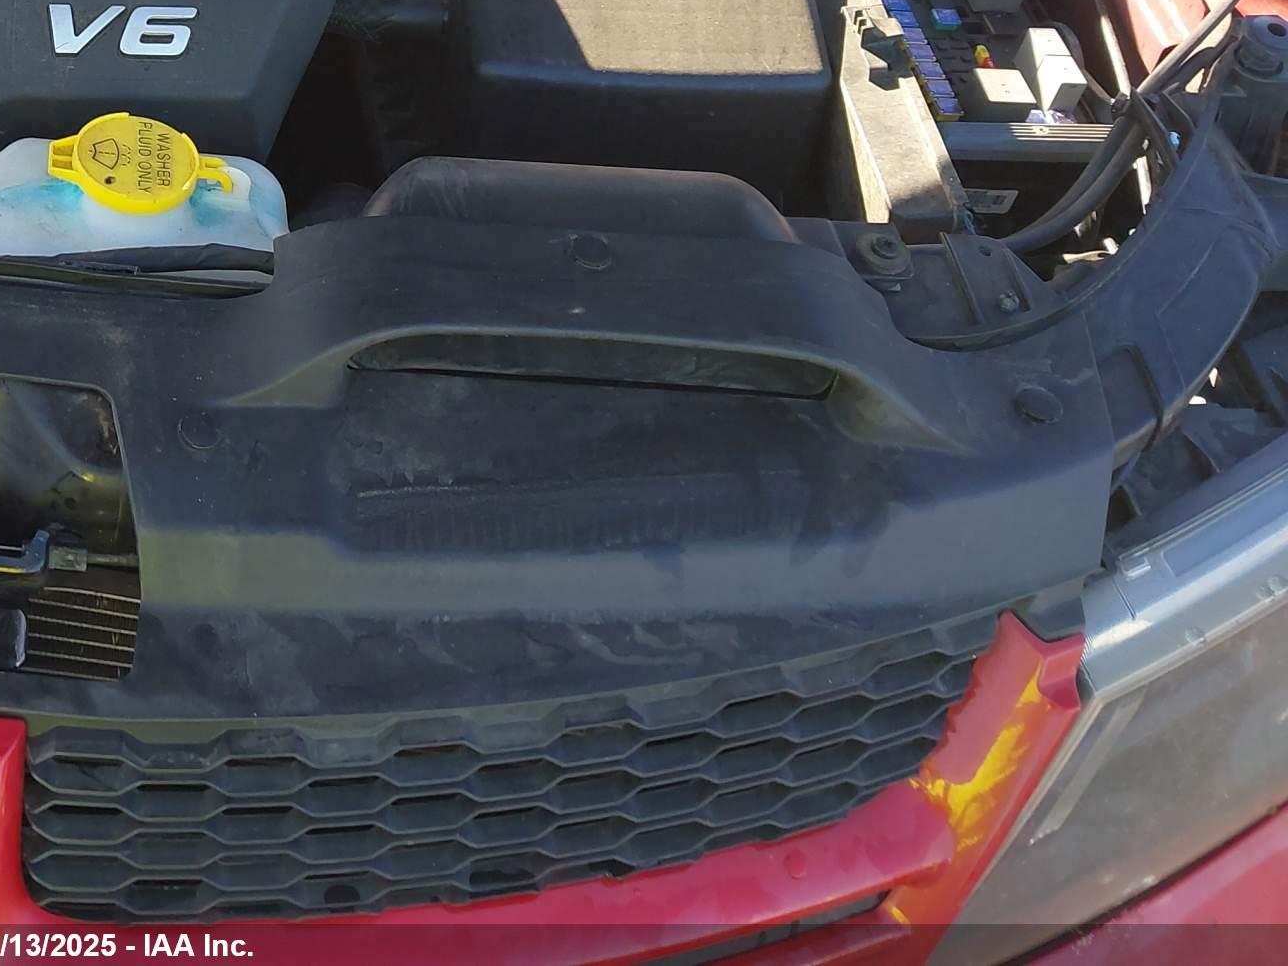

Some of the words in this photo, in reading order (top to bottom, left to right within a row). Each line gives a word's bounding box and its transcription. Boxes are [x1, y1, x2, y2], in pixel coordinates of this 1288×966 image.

[48, 3, 199, 57] V6
[137, 121, 153, 158] FLUID
[156, 132, 171, 187] WASHER
[137, 160, 152, 194] ONLY
